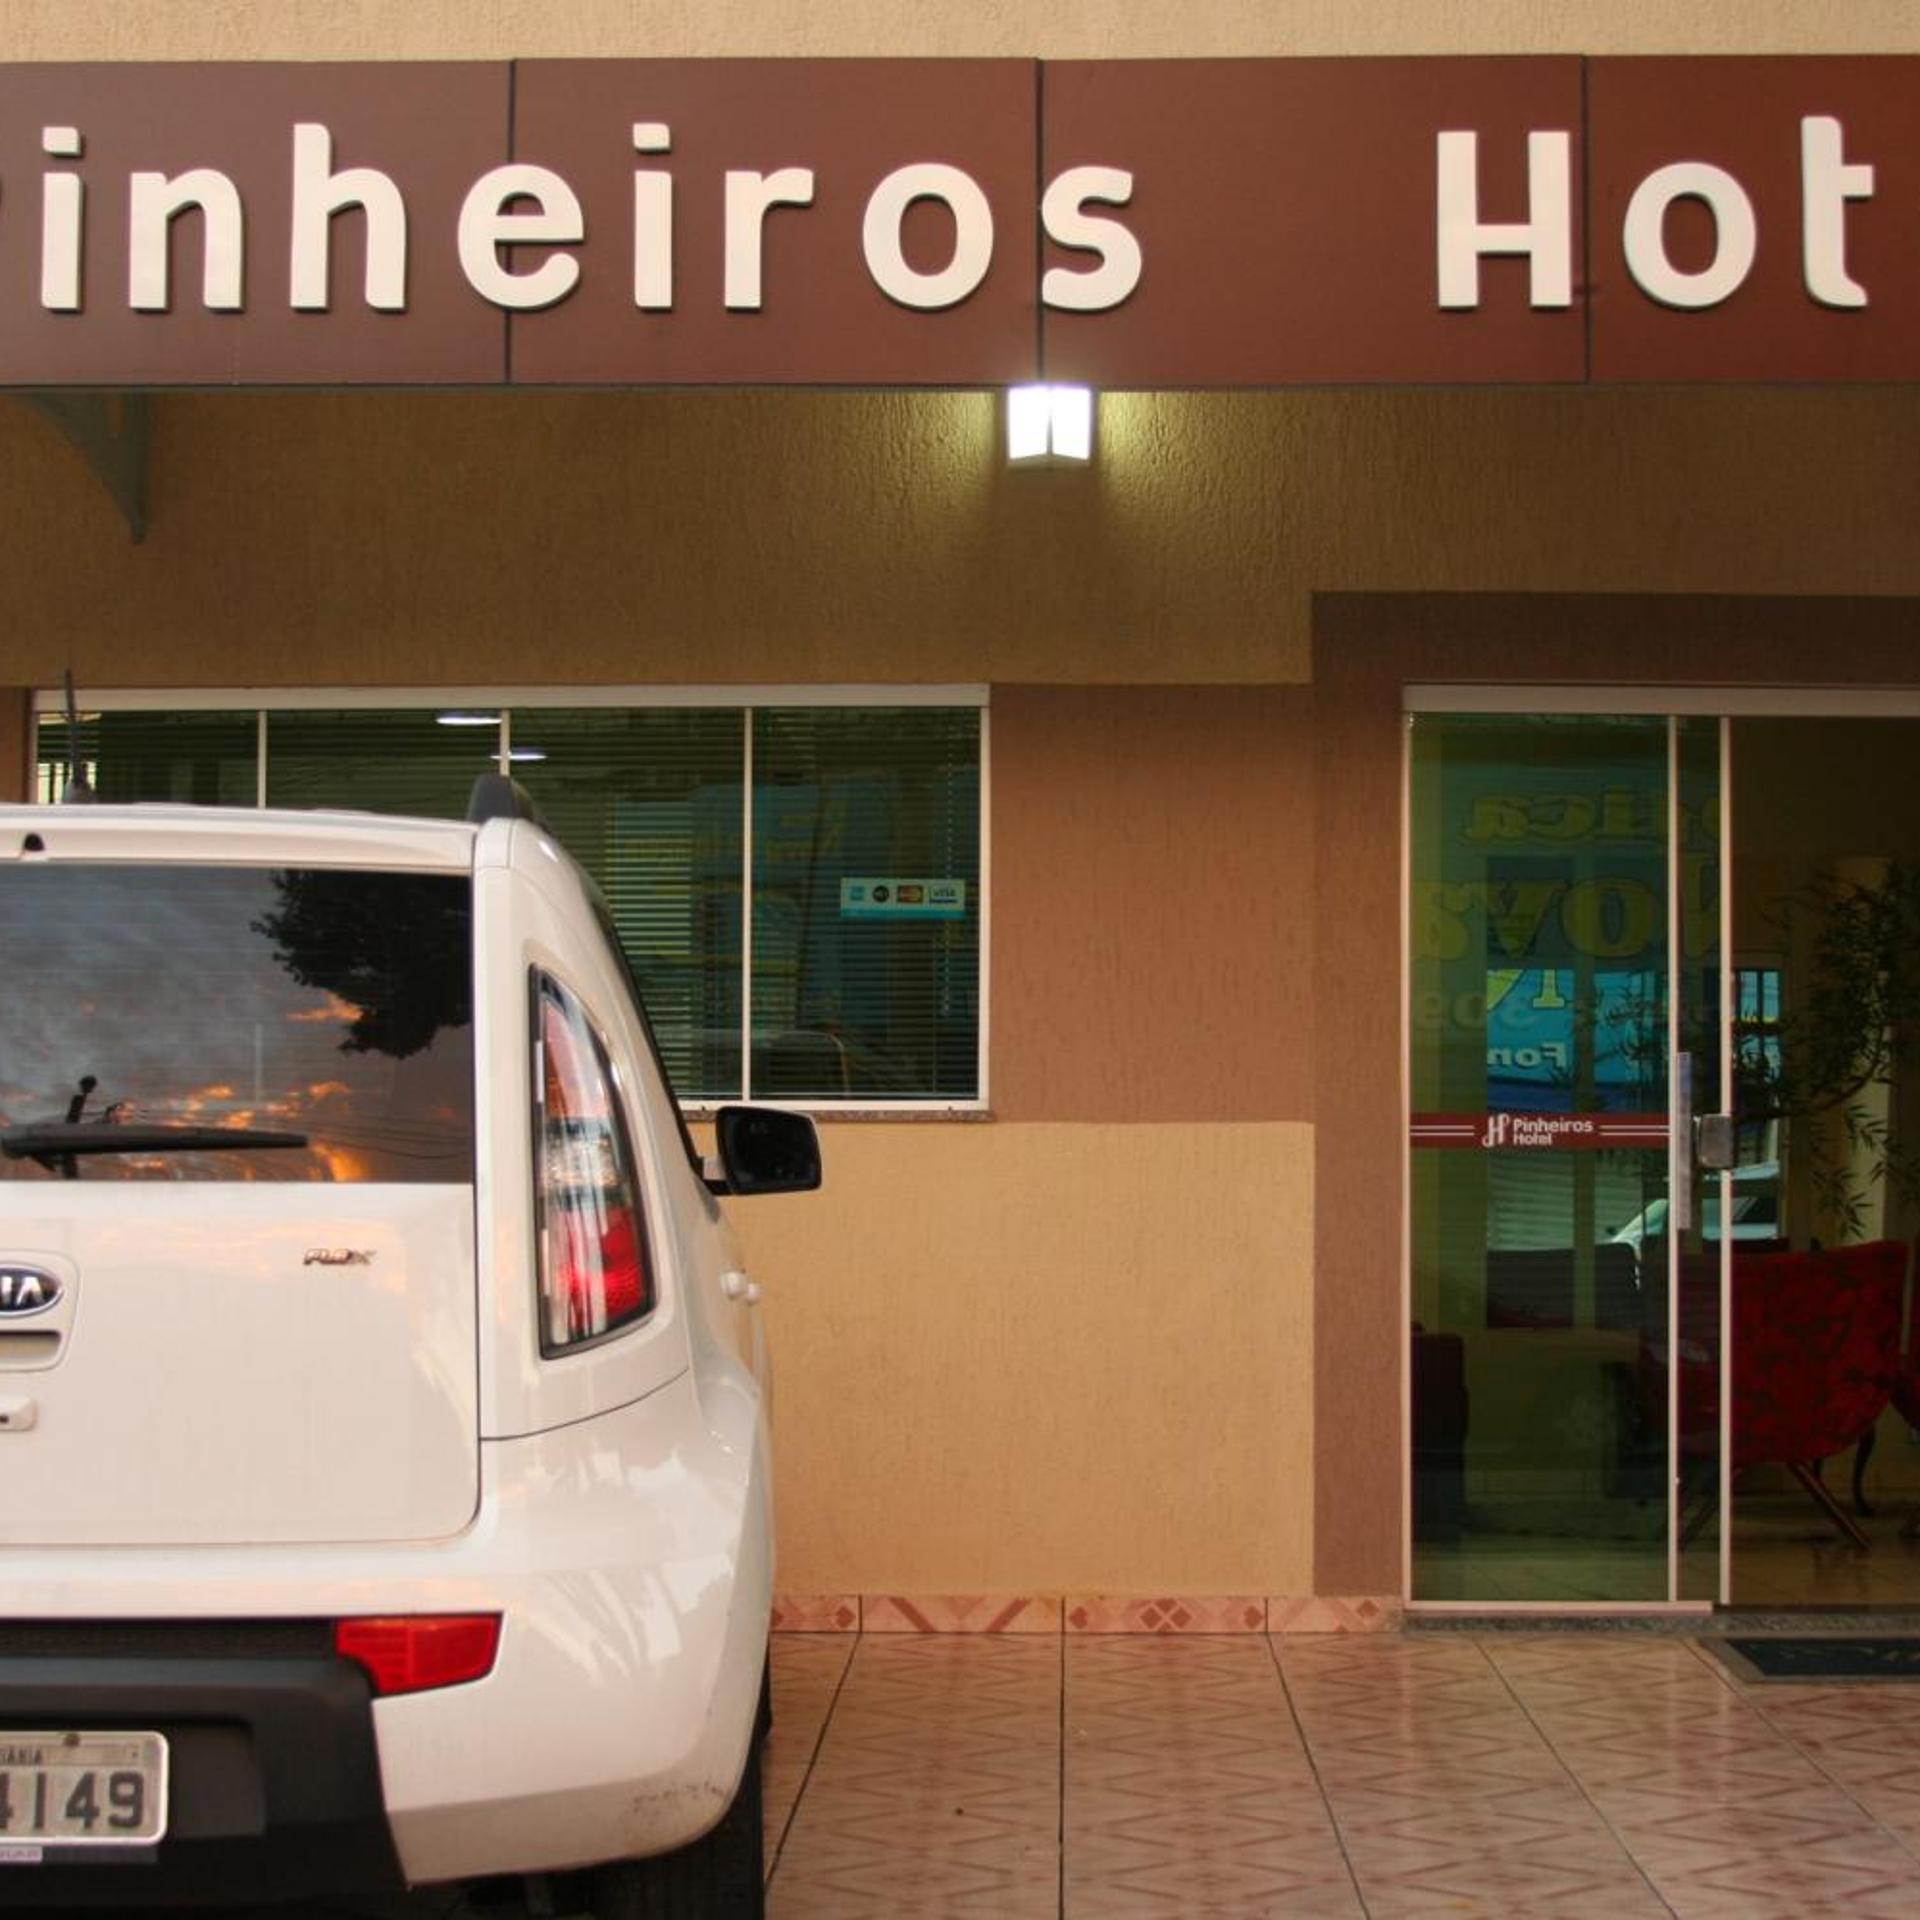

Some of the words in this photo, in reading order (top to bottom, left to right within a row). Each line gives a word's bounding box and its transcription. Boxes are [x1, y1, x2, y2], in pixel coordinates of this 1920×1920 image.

[39, 122, 1143, 311] inheiros
[1437, 115, 1875, 308] Hot
[1512, 1117, 1594, 1134] Pinheiros
[1512, 1132, 1553, 1146] Hotel
